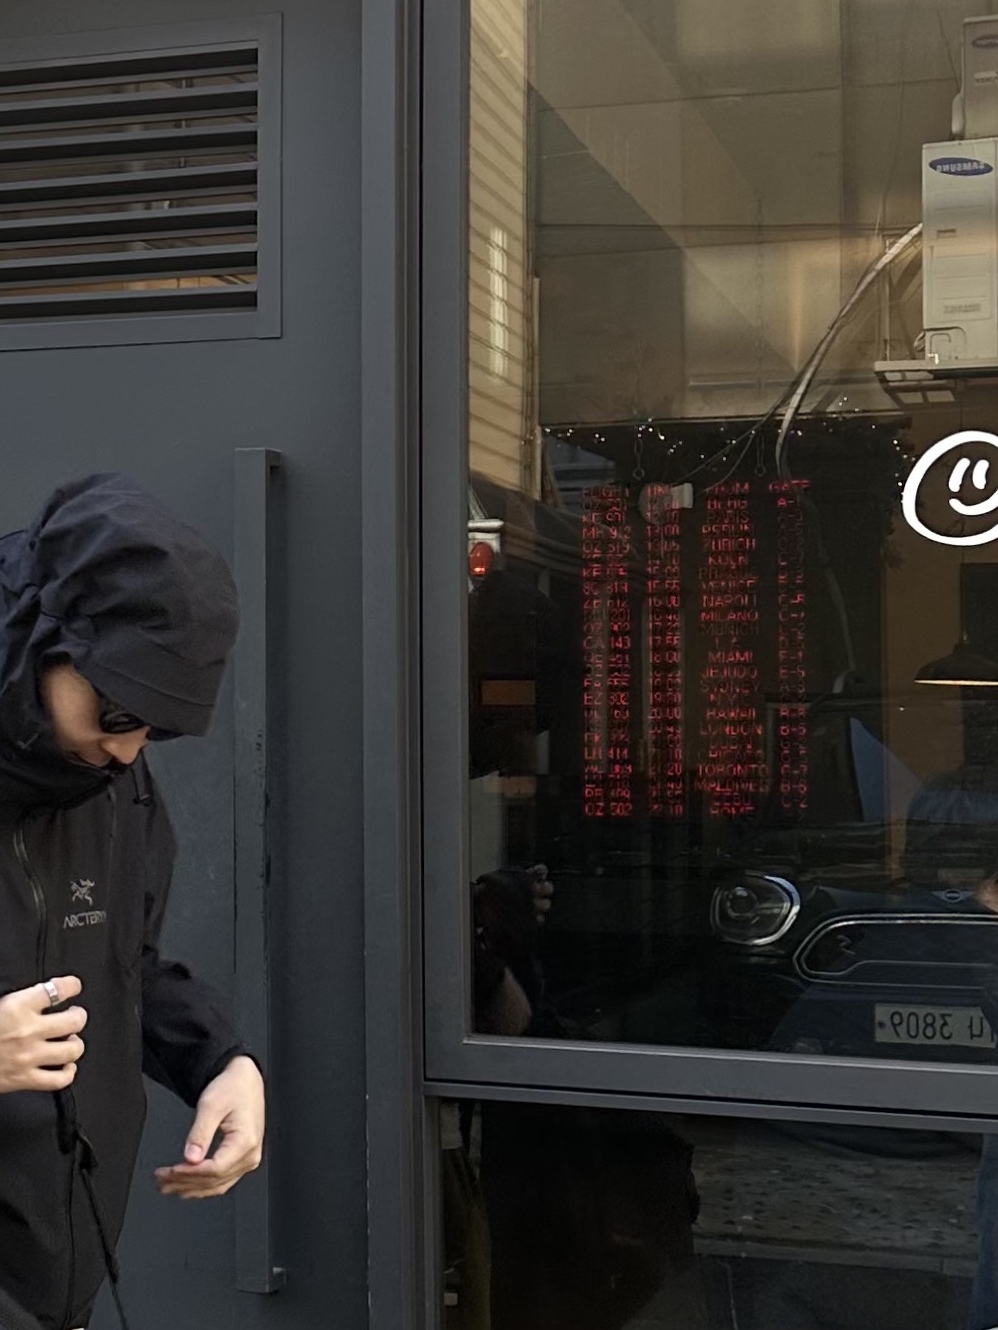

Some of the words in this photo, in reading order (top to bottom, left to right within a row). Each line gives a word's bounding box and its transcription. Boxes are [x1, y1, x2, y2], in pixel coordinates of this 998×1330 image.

[701, 609, 759, 623] MILANO
[708, 650, 753, 664] MIAMI
[697, 763, 770, 777] TORONTO
